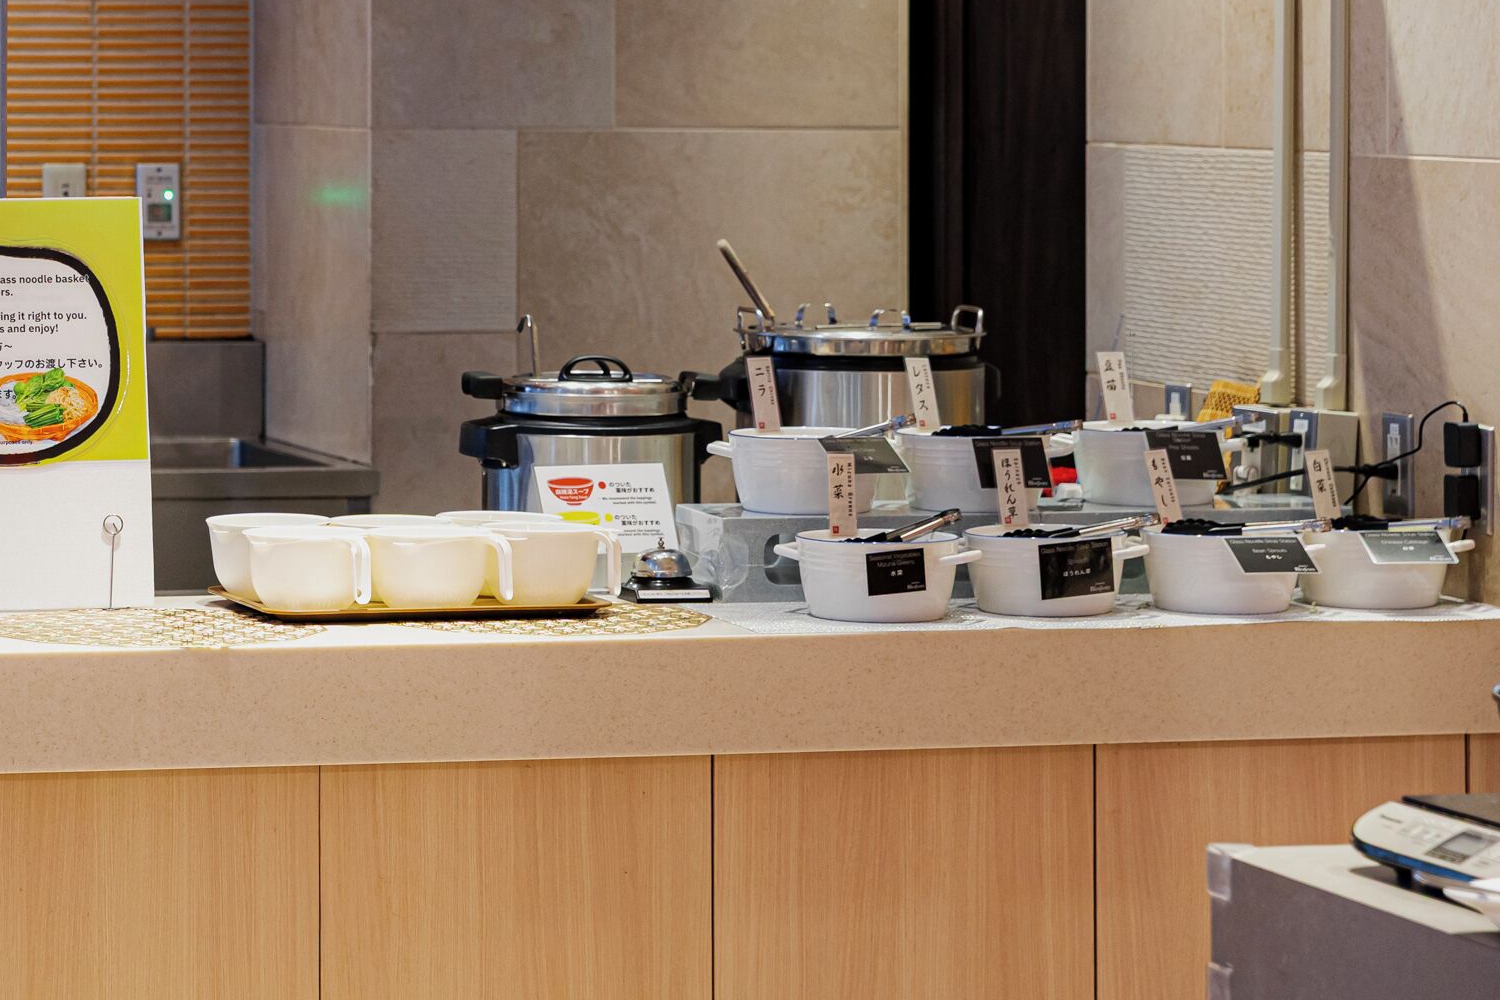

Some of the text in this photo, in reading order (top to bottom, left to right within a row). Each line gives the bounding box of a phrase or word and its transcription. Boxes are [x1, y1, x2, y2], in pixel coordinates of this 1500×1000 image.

[19, 274, 53, 284] noodle
[55, 274, 89, 283] basket
[18, 311, 25, 321] it
[27, 311, 51, 323] right
[53, 311, 64, 320] to
[65, 312, 87, 322] you.
[7, 324, 26, 333] and
[28, 323, 59, 335] enjoy!
[832, 463, 844, 499] 水菜
